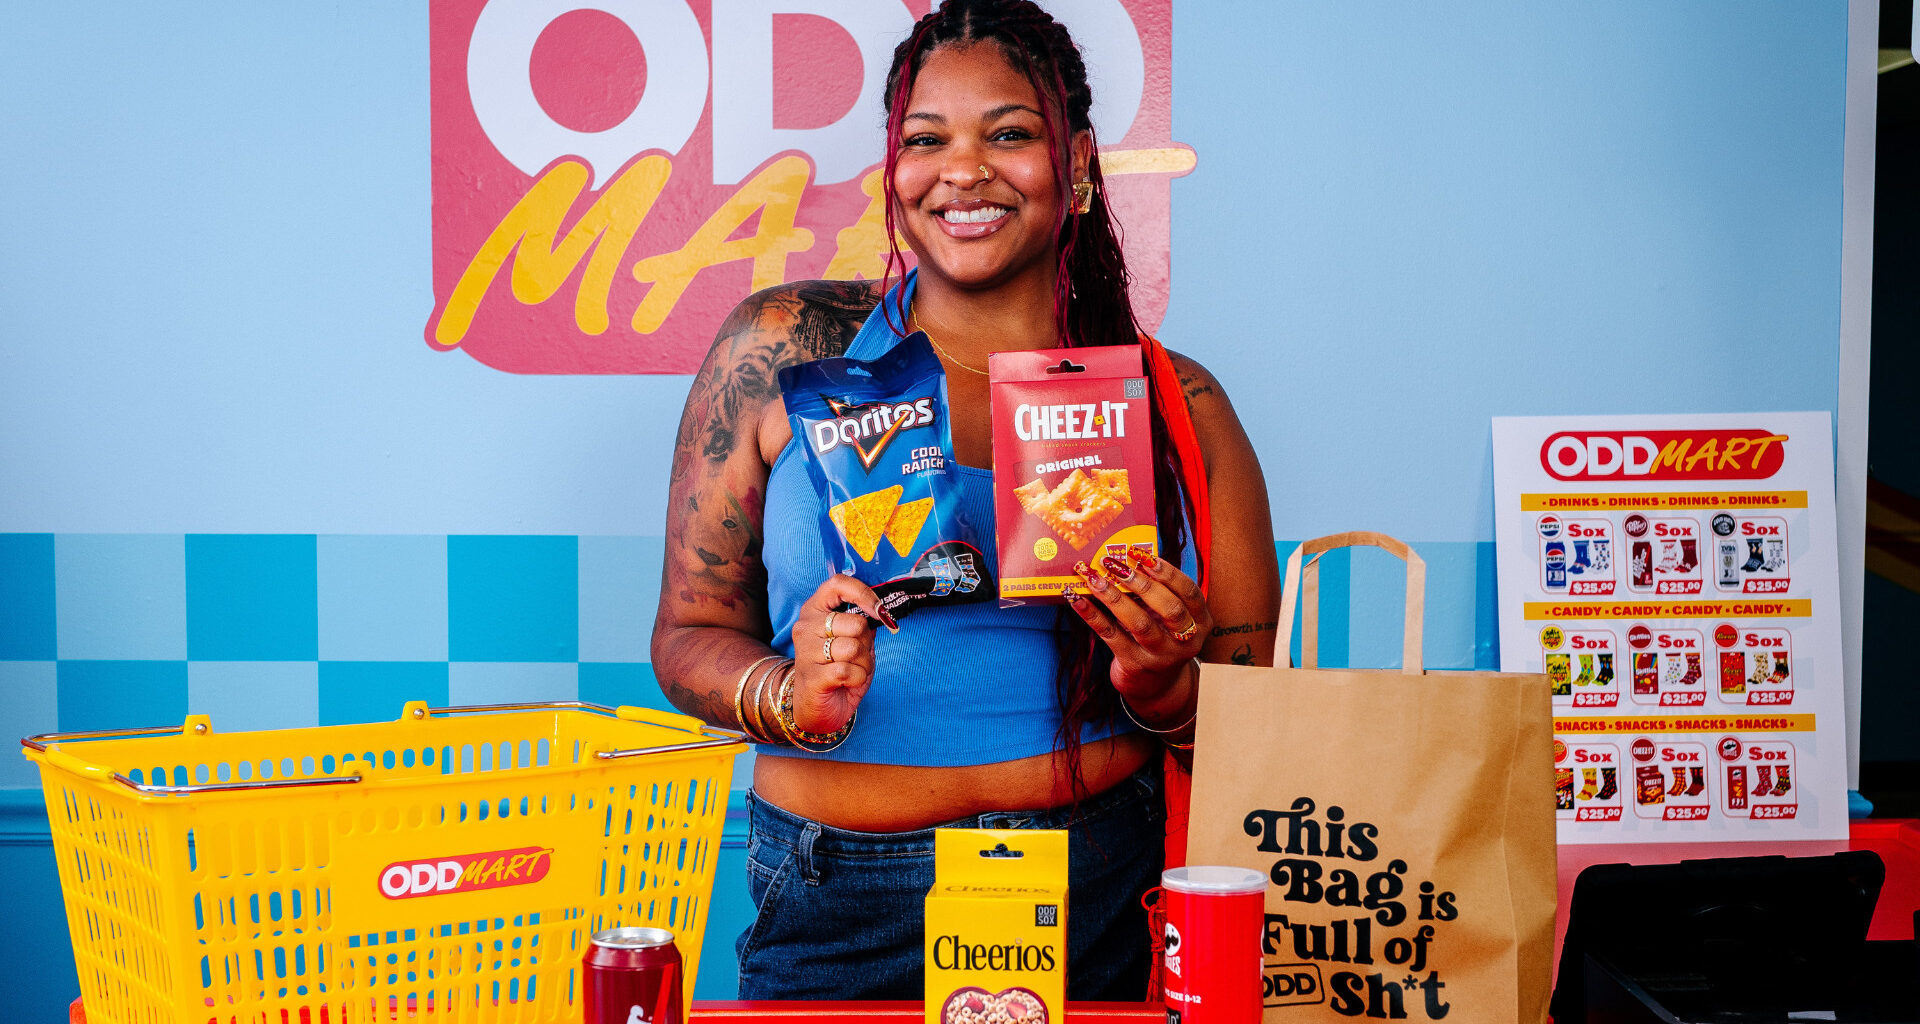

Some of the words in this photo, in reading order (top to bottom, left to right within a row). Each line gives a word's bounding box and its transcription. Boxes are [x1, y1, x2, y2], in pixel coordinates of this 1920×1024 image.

[1127, 380, 1144, 389] ODD
[1127, 388, 1144, 397] SOX
[816, 397, 934, 453] Doritos
[911, 446, 943, 460] COOL
[902, 458, 945, 474] RANCH
[1549, 498, 1599, 507] DRINKS
[1609, 497, 1659, 506] DRINKS
[1668, 496, 1720, 505] DRINKS
[1728, 495, 1780, 505] DRINKS
[1568, 523, 1606, 537] Sox
[1654, 523, 1692, 537] Sox
[1741, 522, 1779, 536] Sox
[1003, 584, 1010, 592] 2
[1010, 584, 1037, 592] PAIRS
[1038, 582, 1063, 590] CREW
[1573, 582, 1614, 594] $25.00
[1659, 581, 1701, 594] $25.00
[1747, 580, 1788, 592] $25.00
[1552, 606, 1602, 616] CANDY
[1612, 606, 1662, 616] CANDY
[1672, 605, 1723, 615] CANDY
[1733, 604, 1784, 614] CANDY
[1571, 635, 1609, 649] Sox
[1658, 634, 1696, 648] Sox
[1745, 633, 1784, 647] Sox
[1576, 693, 1617, 705] $25.00
[1662, 693, 1704, 705] $25.00
[1750, 692, 1792, 704] $25.00
[1555, 721, 1606, 731] SNACKS
[1615, 720, 1666, 731] SNACKS
[1675, 719, 1727, 730] SNACKS
[1736, 718, 1788, 729] SNACKS
[1574, 749, 1613, 763] Sox
[1661, 748, 1699, 762] Sox
[1749, 746, 1787, 761] Sox
[1579, 808, 1621, 820] $25.00
[1666, 807, 1708, 819] $25.00
[1754, 806, 1796, 818] $25.00
[1243, 797, 1379, 862] This
[944, 884, 1052, 895] Cheerios
[1270, 859, 1408, 927] Bag
[1418, 881, 1459, 922] is
[1038, 906, 1057, 916] ODD
[1038, 916, 1055, 925] SOX
[1263, 913, 1375, 966] Full
[1384, 925, 1436, 971] of
[933, 935, 1056, 972] Cheerios
[1184, 993, 1202, 1004] 8-12
